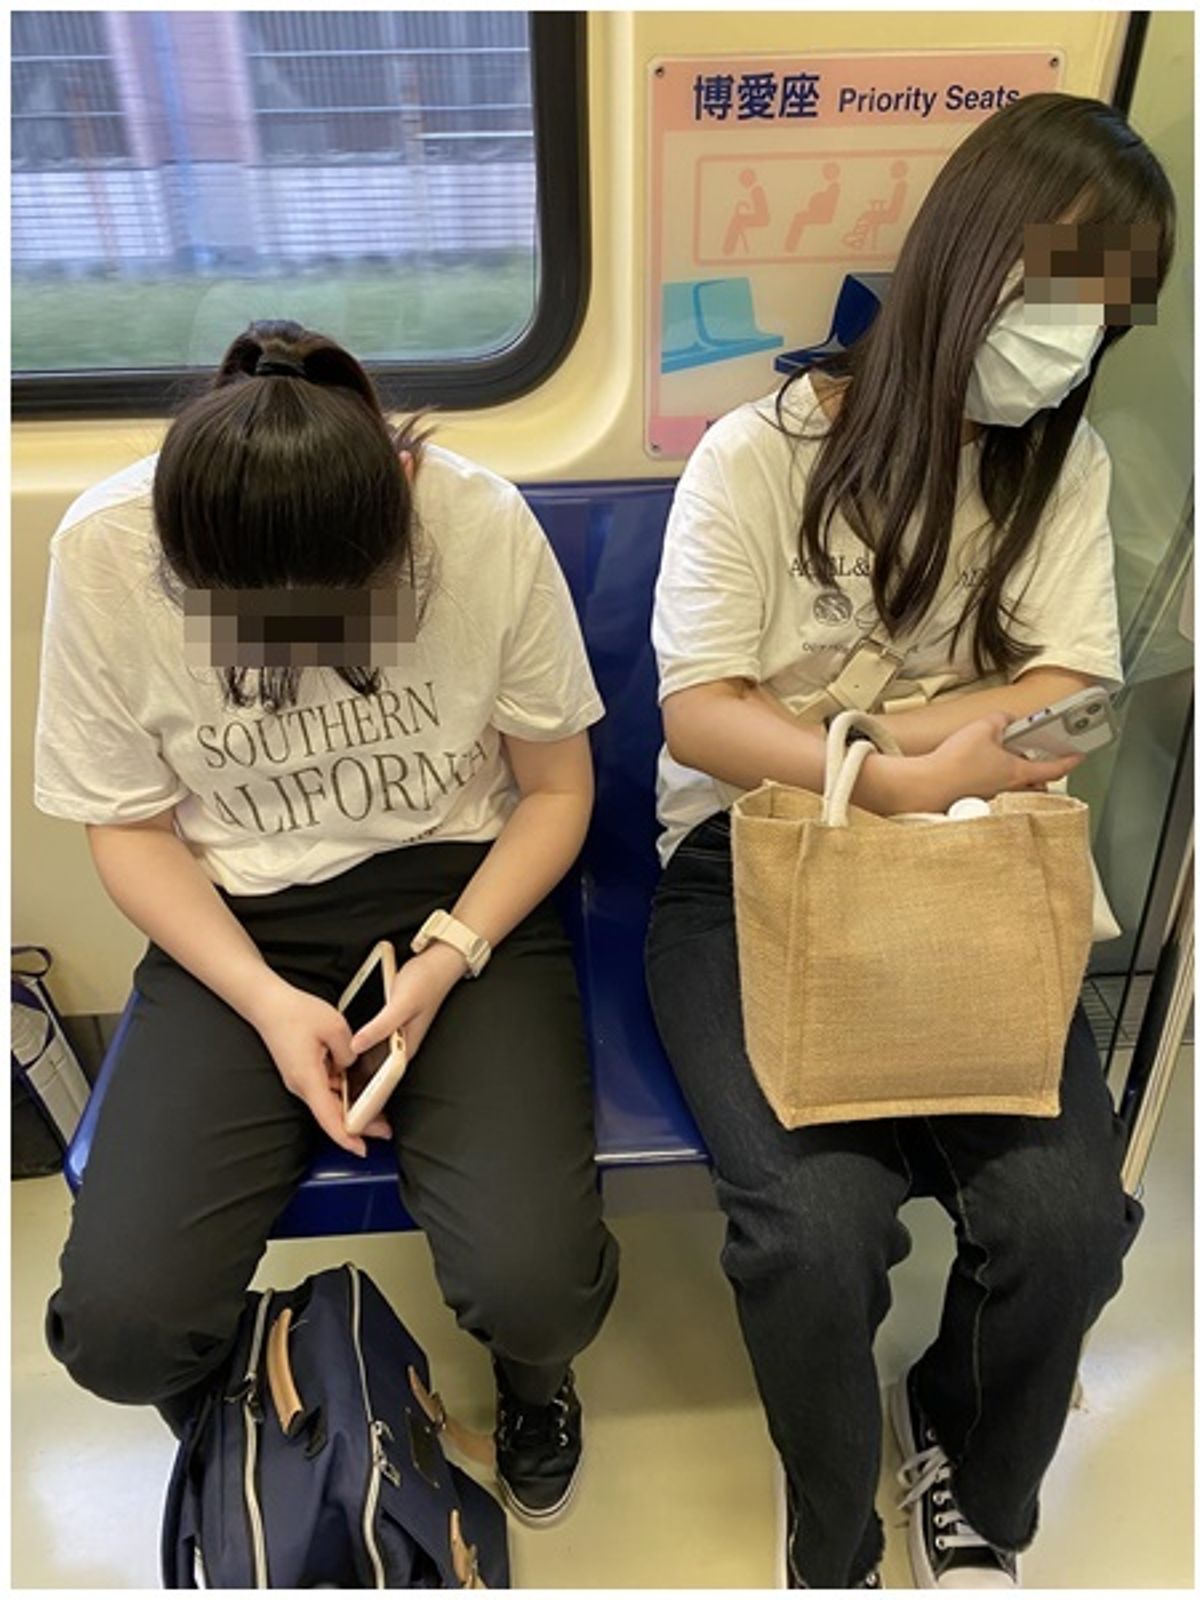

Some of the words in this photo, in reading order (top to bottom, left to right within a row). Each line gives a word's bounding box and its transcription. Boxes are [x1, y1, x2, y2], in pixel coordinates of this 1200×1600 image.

[693, 72, 821, 121] 博愛座
[838, 86, 937, 118] Priority
[945, 84, 1020, 112] Seats
[196, 681, 441, 770] SOUTHERN
